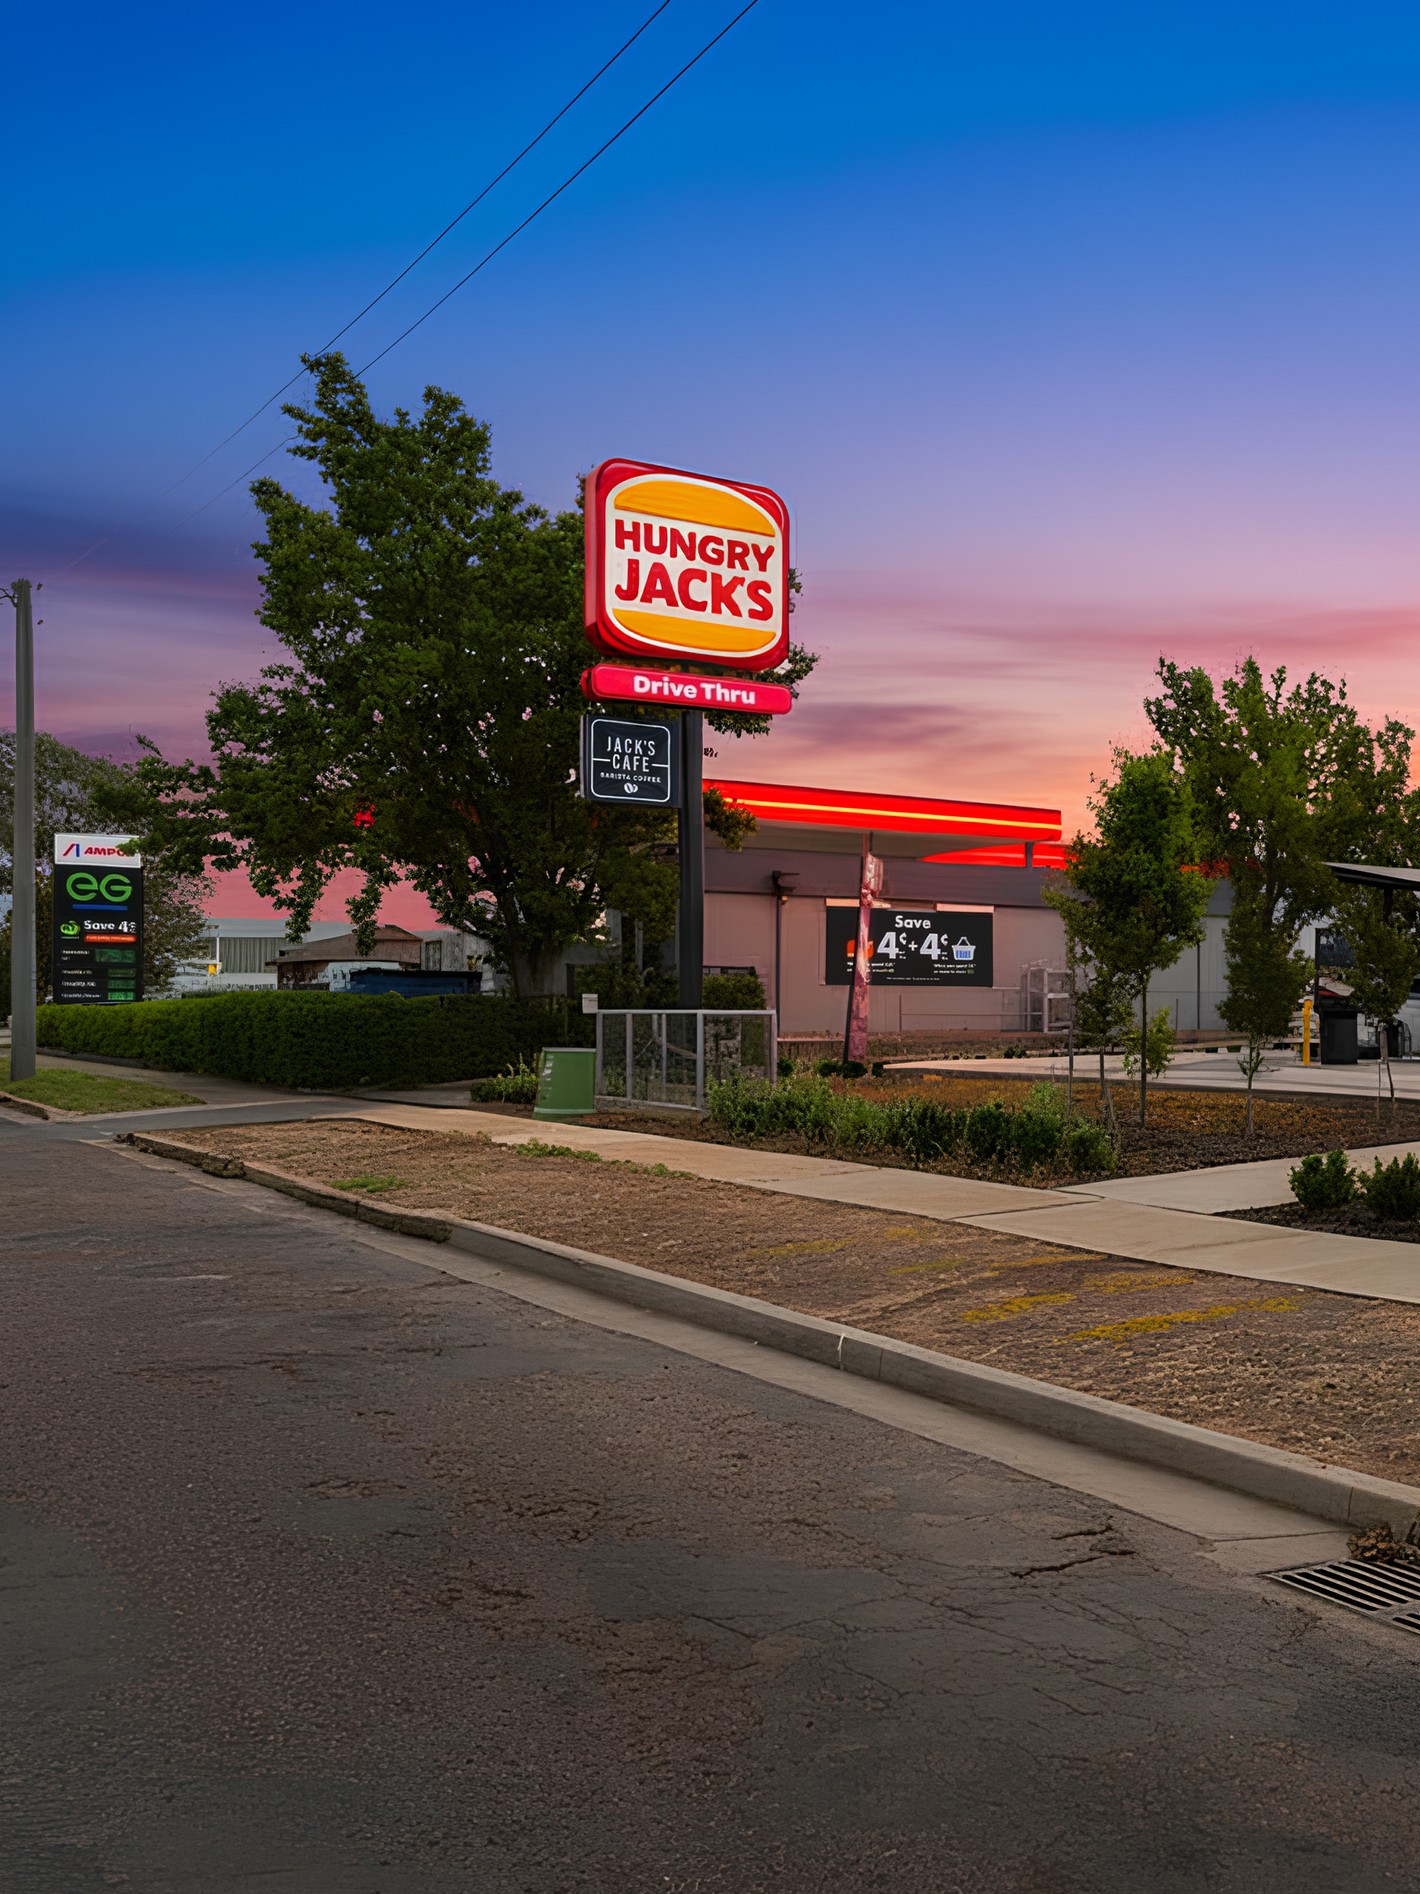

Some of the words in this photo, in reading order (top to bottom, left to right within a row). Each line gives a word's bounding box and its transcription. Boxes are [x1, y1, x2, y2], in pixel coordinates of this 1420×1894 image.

[615, 518, 775, 572] HUNGRY
[633, 675, 697, 698] Drive
[700, 683, 756, 705] Thru
[606, 736, 656, 756] JACK'S
[612, 753, 650, 772] CAFE
[84, 920, 115, 930] Save
[895, 915, 931, 929] Save
